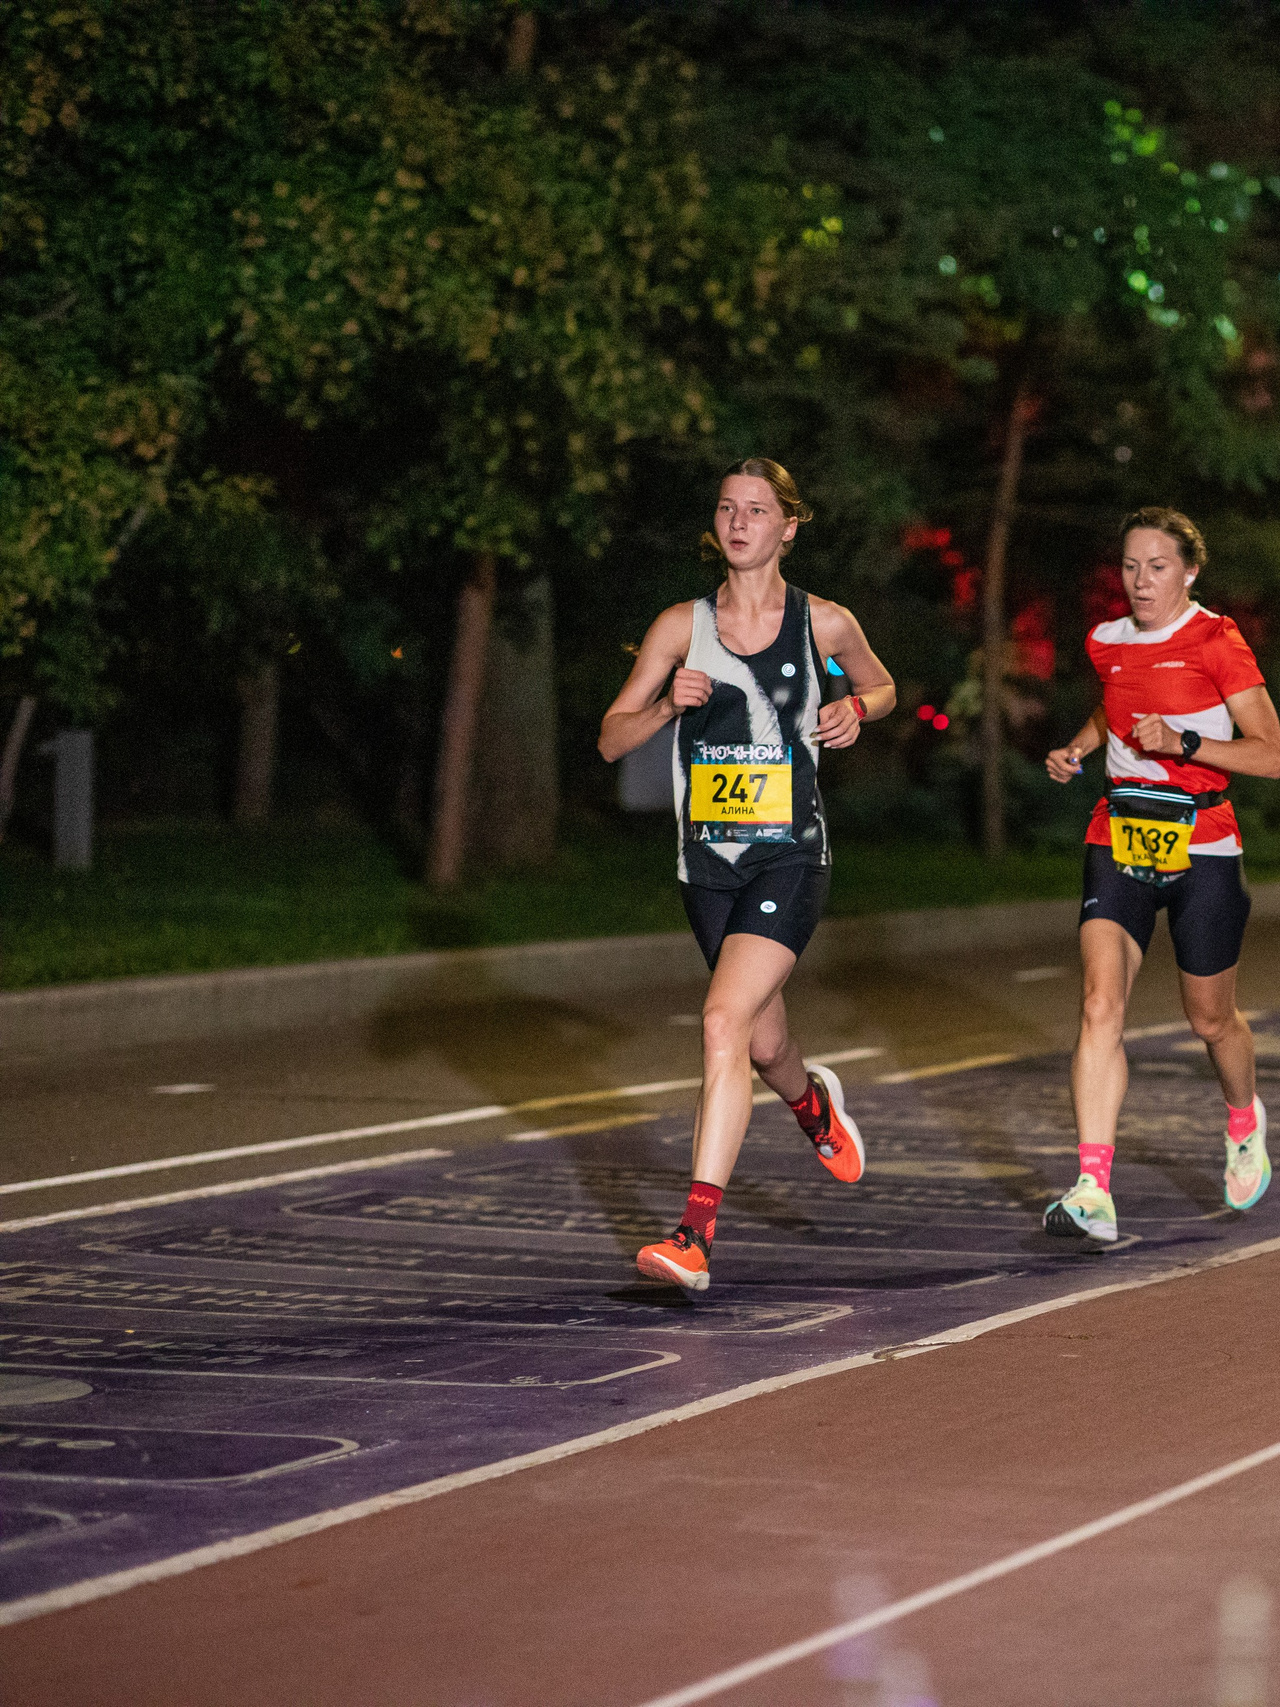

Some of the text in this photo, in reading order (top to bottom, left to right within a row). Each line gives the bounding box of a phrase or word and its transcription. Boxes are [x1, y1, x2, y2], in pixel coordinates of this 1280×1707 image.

[701, 744, 783, 760] НОЧНОЙ
[712, 773, 768, 803] 247
[721, 806, 755, 815] АЛИНА
[699, 825, 711, 840] A
[1122, 824, 1179, 855] 7139
[9, 1348, 267, 1365] ногой
